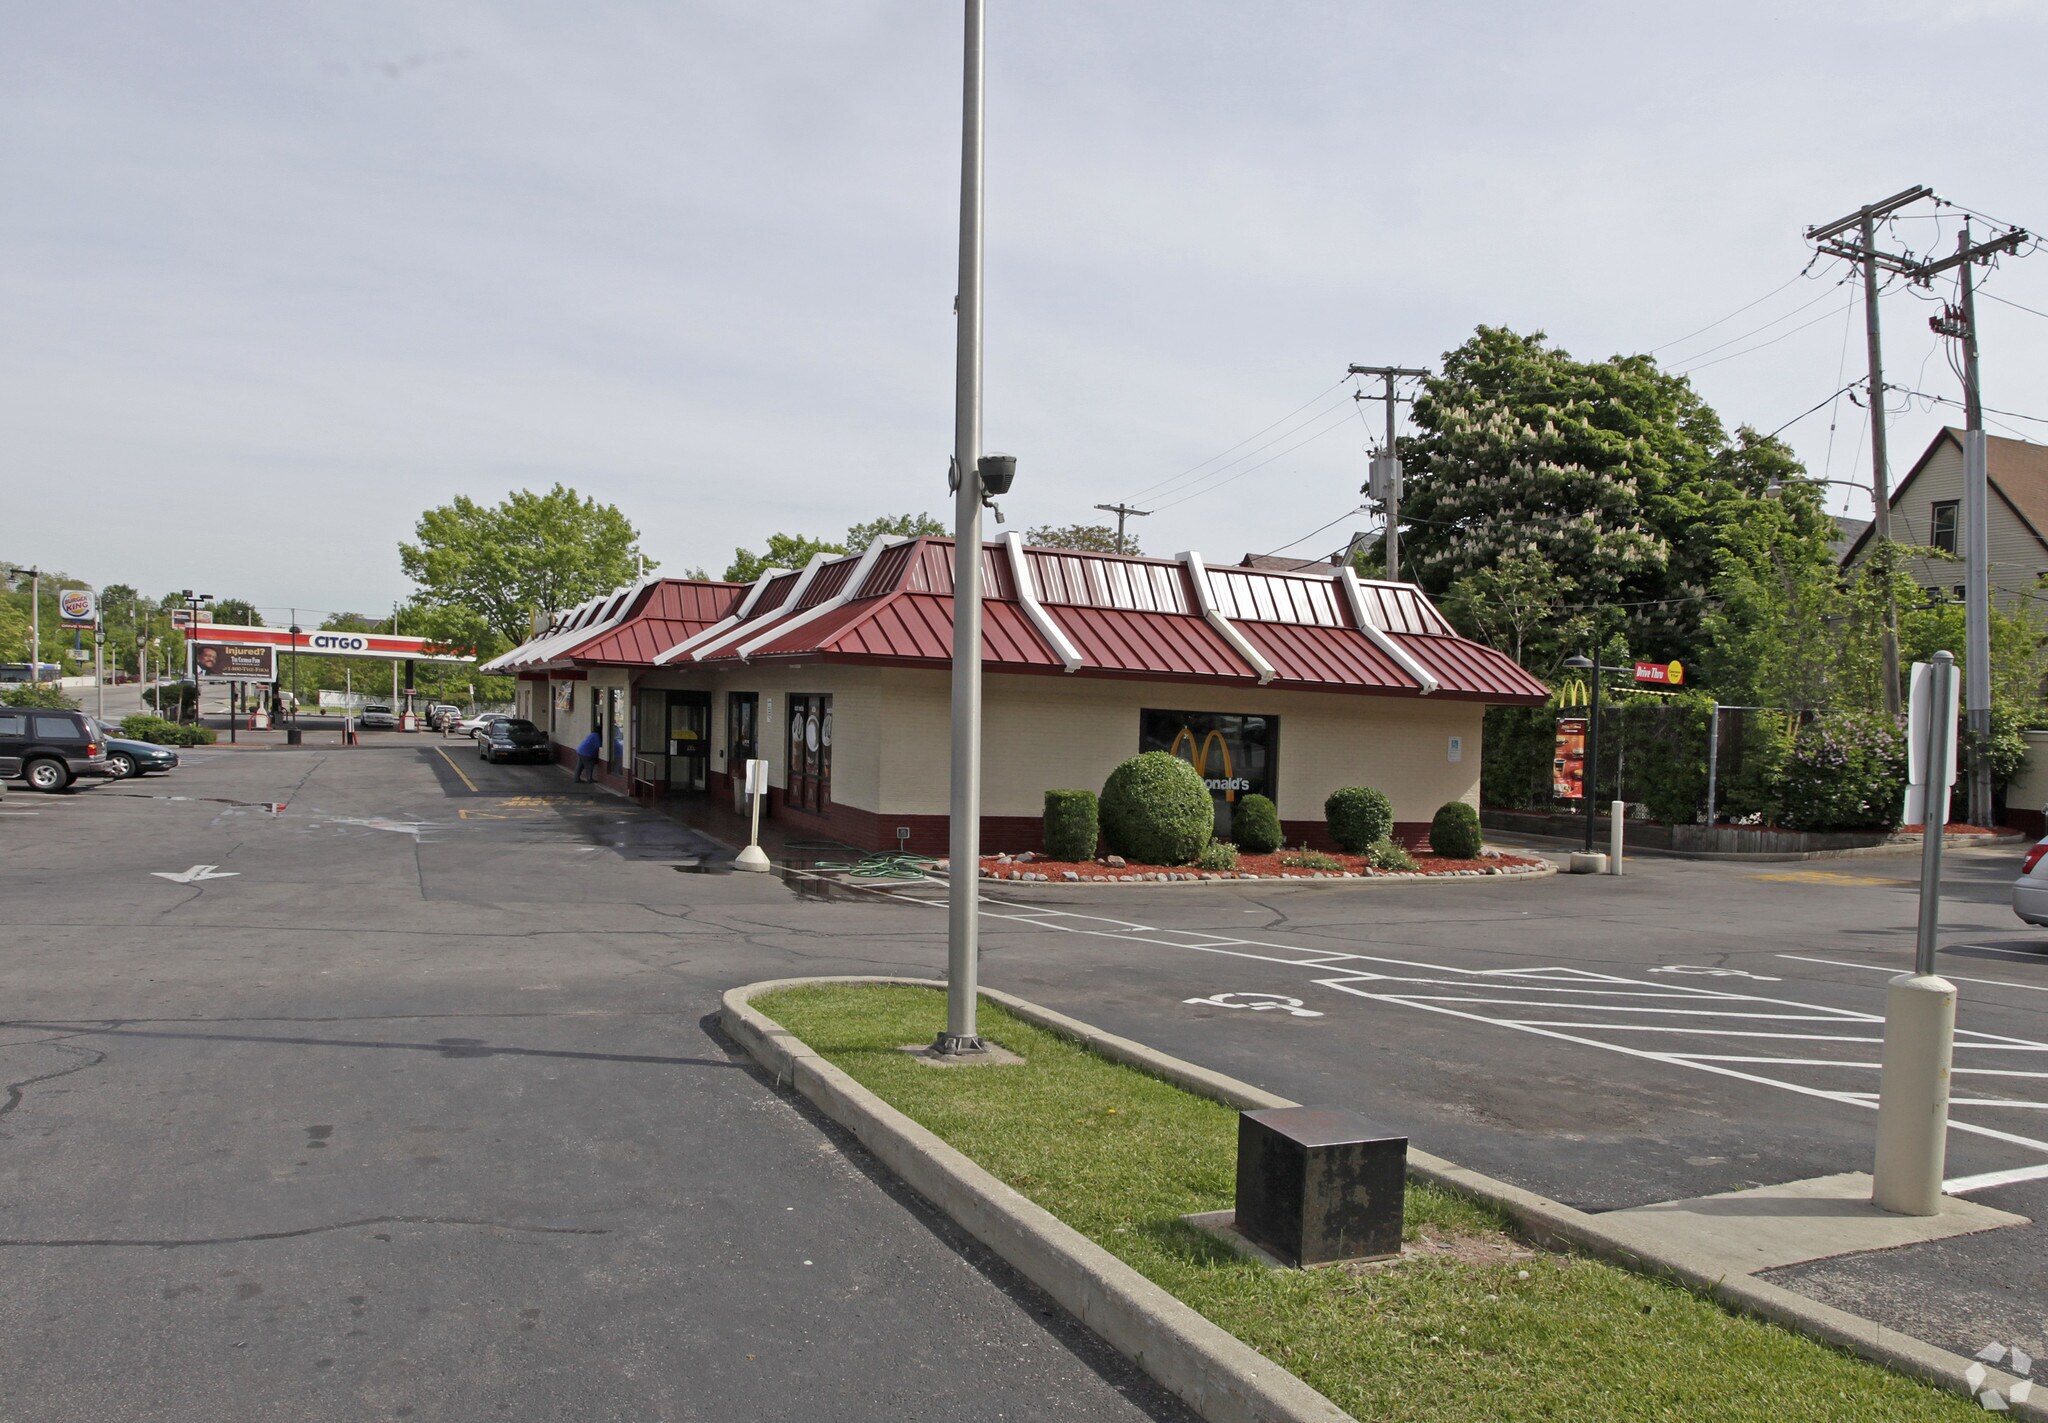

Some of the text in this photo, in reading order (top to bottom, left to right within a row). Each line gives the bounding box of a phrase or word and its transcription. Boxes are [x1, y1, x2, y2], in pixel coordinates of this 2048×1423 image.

[65, 596, 88, 604] BURGER
[66, 601, 88, 611] KING
[315, 636, 362, 650] CITGO
[225, 646, 266, 656] Injured?
[1636, 666, 1651, 678] Drive
[1651, 667, 1664, 679] Thru
[1204, 777, 1250, 790] onald's
